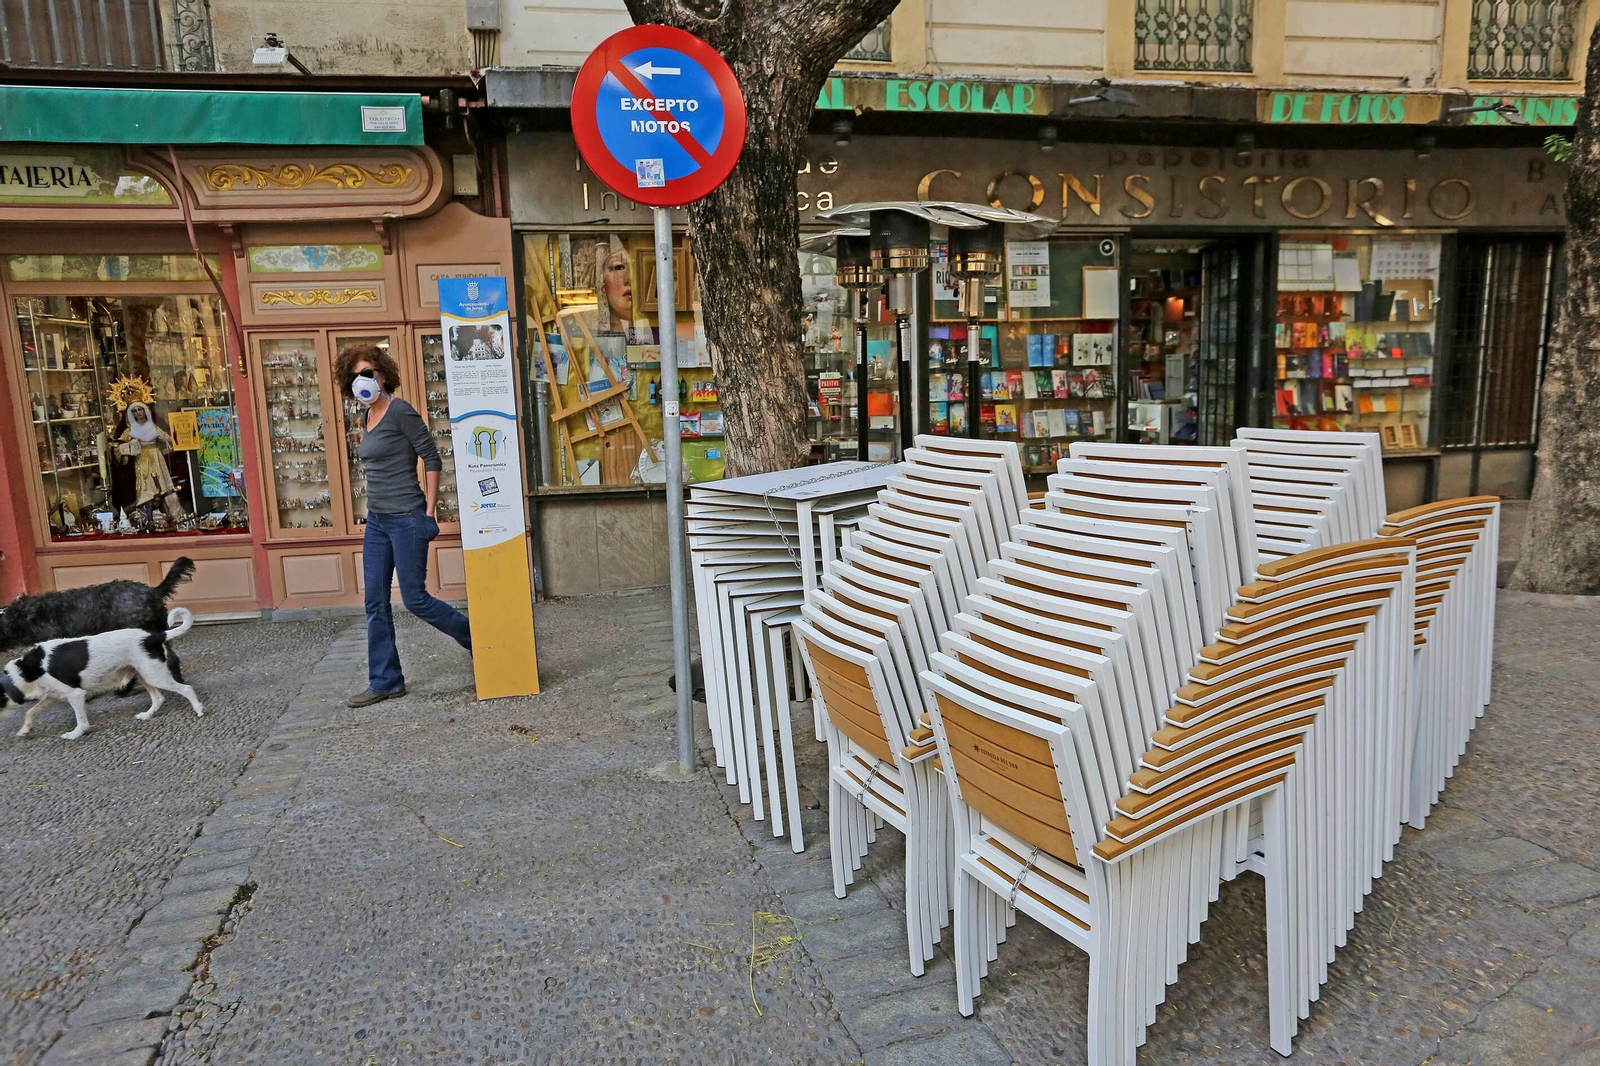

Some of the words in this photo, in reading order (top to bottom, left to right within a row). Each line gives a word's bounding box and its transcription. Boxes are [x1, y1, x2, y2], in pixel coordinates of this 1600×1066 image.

[620, 97, 699, 112] EXCEPTO
[885, 80, 1035, 114] ESCOLAR
[1270, 93, 1313, 123] DE
[1319, 93, 1408, 124] FOTOS
[630, 120, 692, 134] MOTOS
[916, 169, 1477, 226] CONSISTORIO
